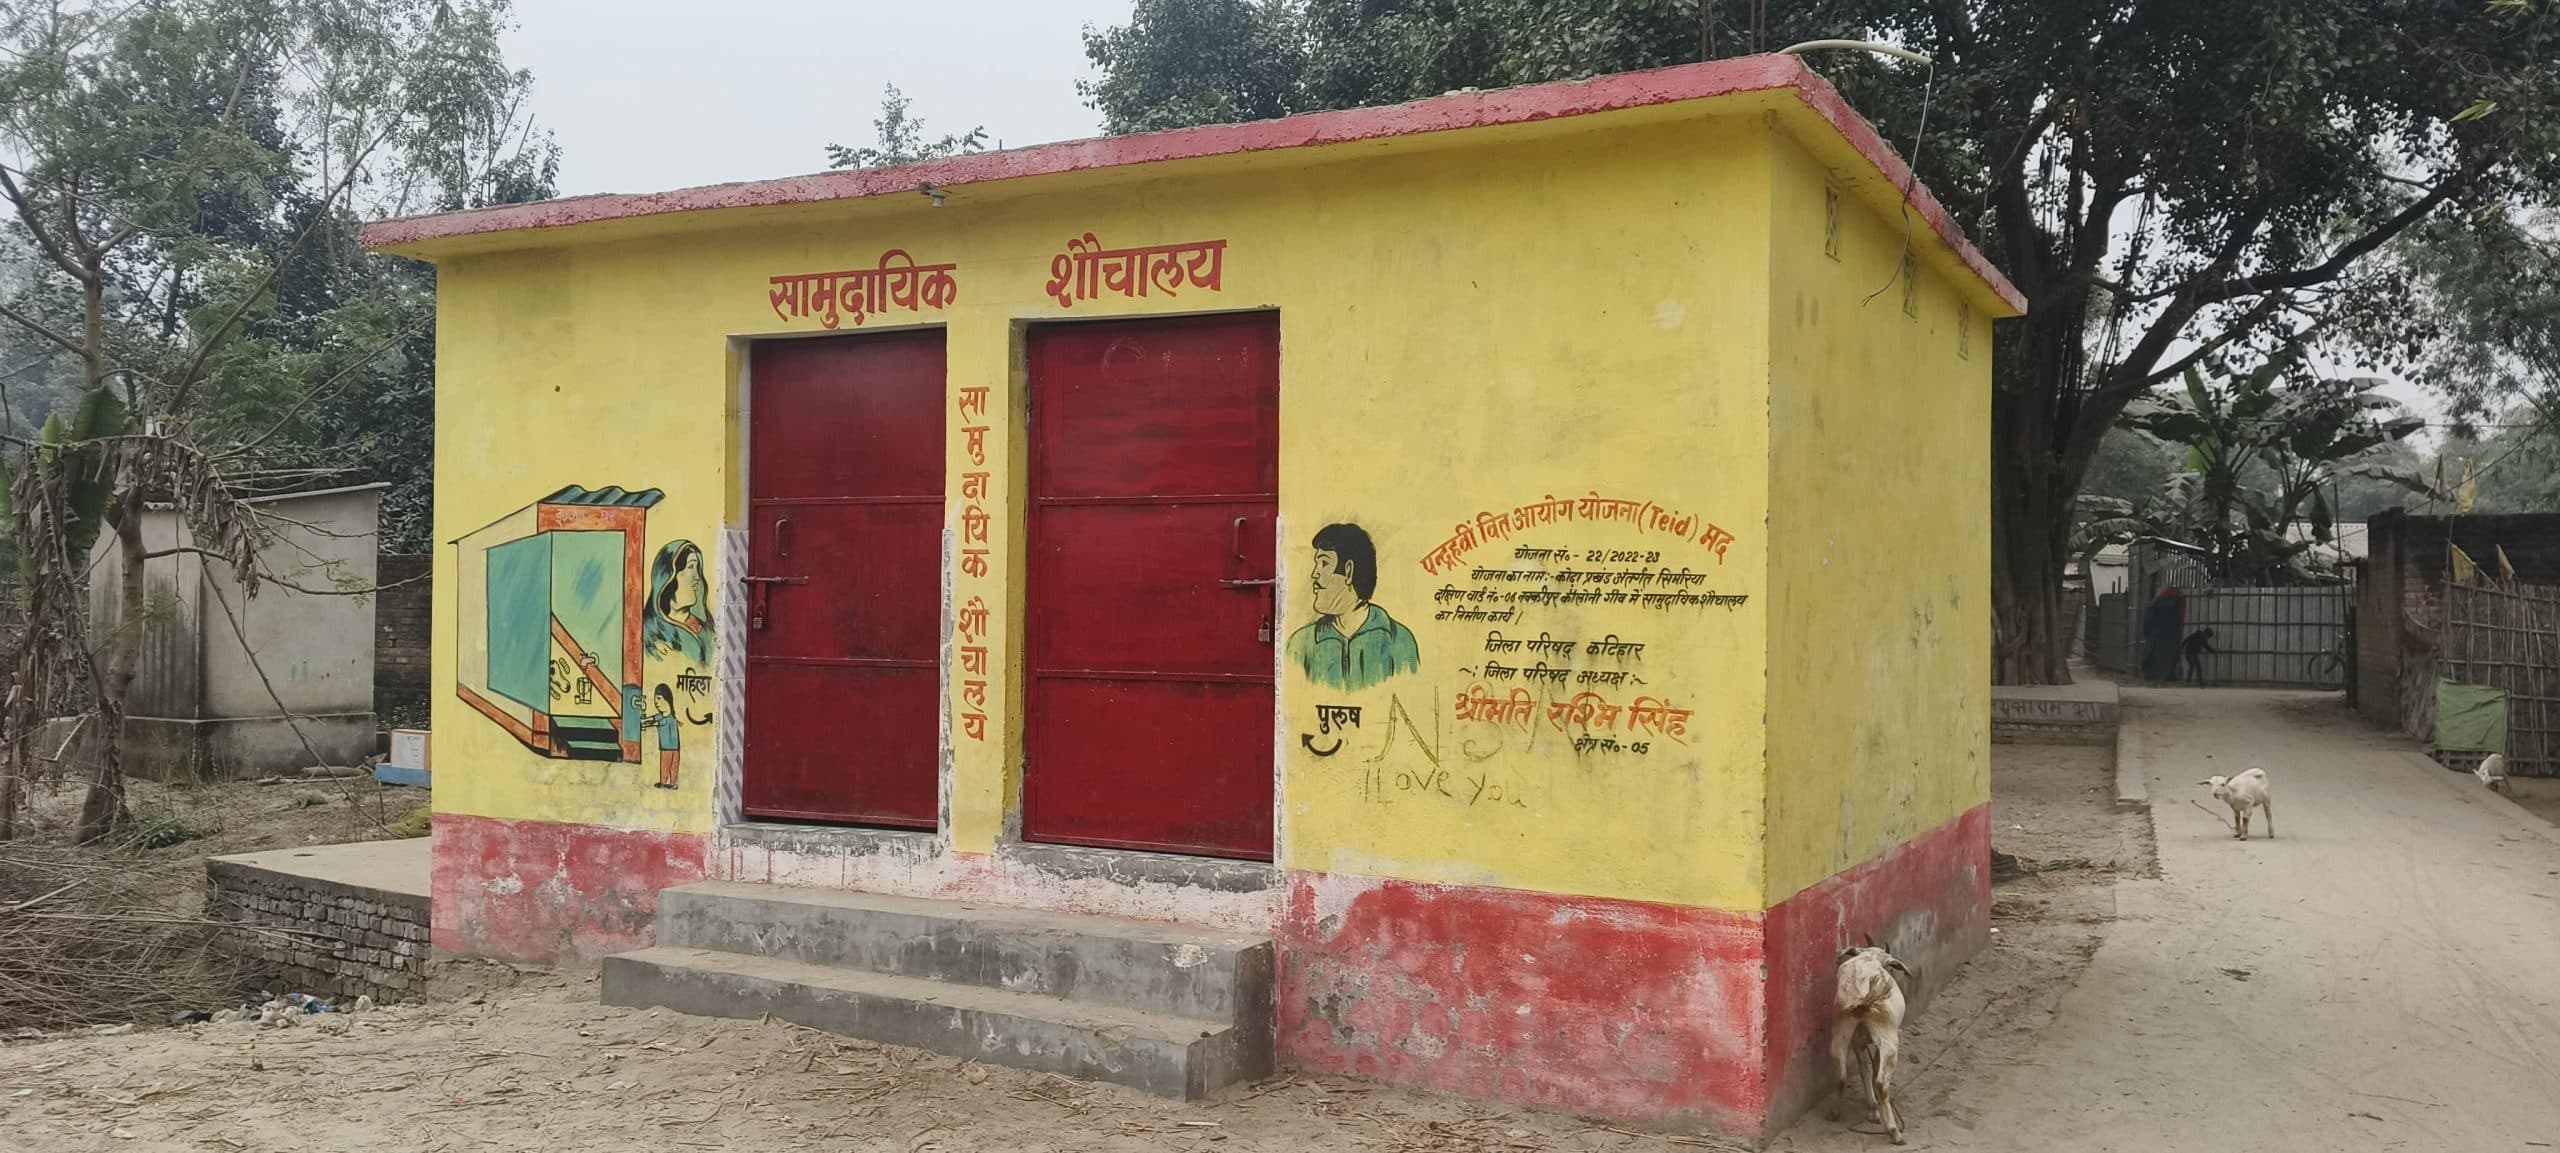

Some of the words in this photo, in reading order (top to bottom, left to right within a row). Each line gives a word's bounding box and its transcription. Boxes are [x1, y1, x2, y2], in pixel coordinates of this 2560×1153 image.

[769, 249, 956, 329] सामुदायिक
[1045, 232, 1227, 308] शौचालय
[1512, 494, 1575, 531] आयोग
[1577, 491, 1642, 524] योजना
[1699, 523, 1735, 565] मद
[1514, 544, 1553, 562] योजना
[1656, 567, 1707, 589] सिमरिया
[1434, 584, 1468, 606] दक्षिण
[1466, 586, 1487, 602] वार्ड
[1628, 588, 1644, 605] में
[1435, 610, 1452, 622] का
[1451, 605, 1488, 623] निर्माण
[1484, 630, 1521, 654] जिला
[1586, 634, 1646, 662] कटिहार
[676, 667, 712, 703] महिला
[1483, 660, 1518, 681] जिला
[1576, 669, 1629, 691] अध्यक्ष
[1547, 691, 1622, 733] रश्मि
[1628, 695, 1695, 746] सिंह
[1573, 733, 1599, 758] क्षेत्र
